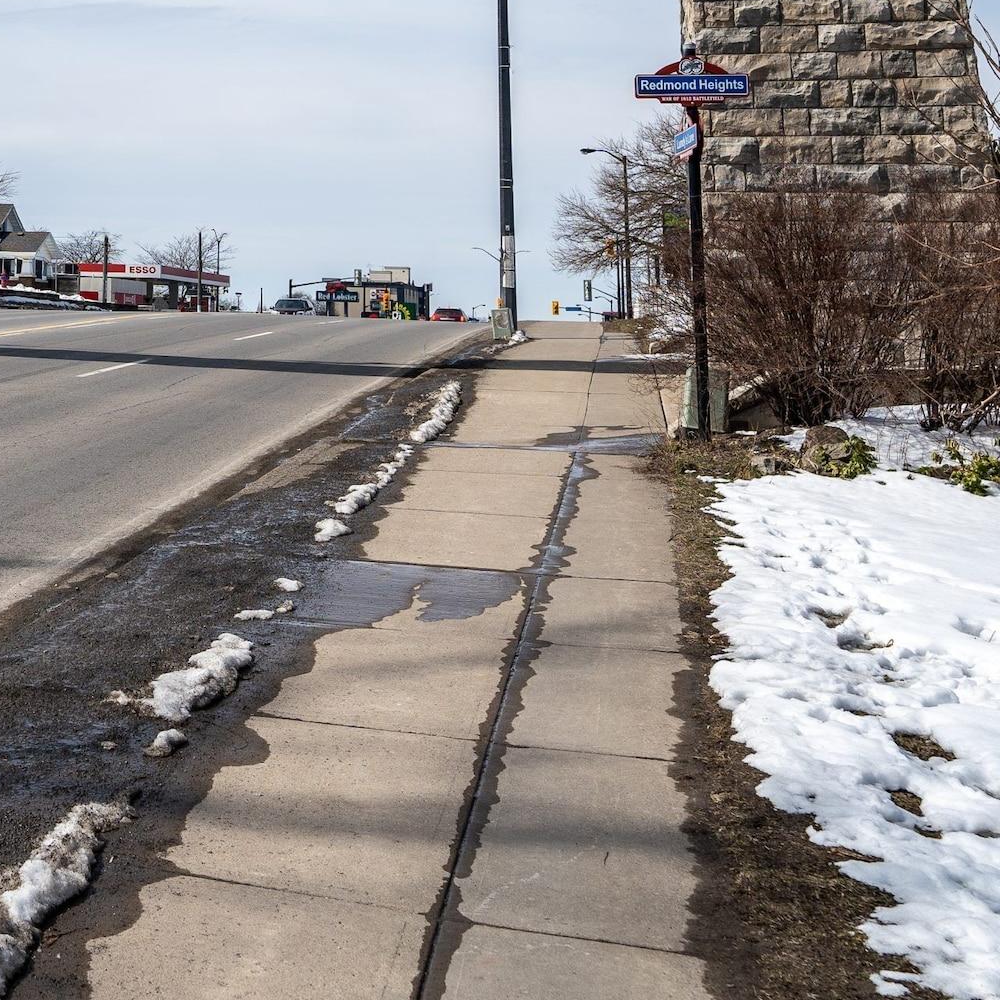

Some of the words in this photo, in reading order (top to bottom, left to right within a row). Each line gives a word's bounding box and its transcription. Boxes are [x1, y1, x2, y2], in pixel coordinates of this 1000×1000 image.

[640, 79, 697, 91] Redmond
[699, 79, 745, 93] Heights
[129, 266, 157, 274] ESSO
[318, 292, 331, 300] Red
[332, 292, 357, 301] Lobster
